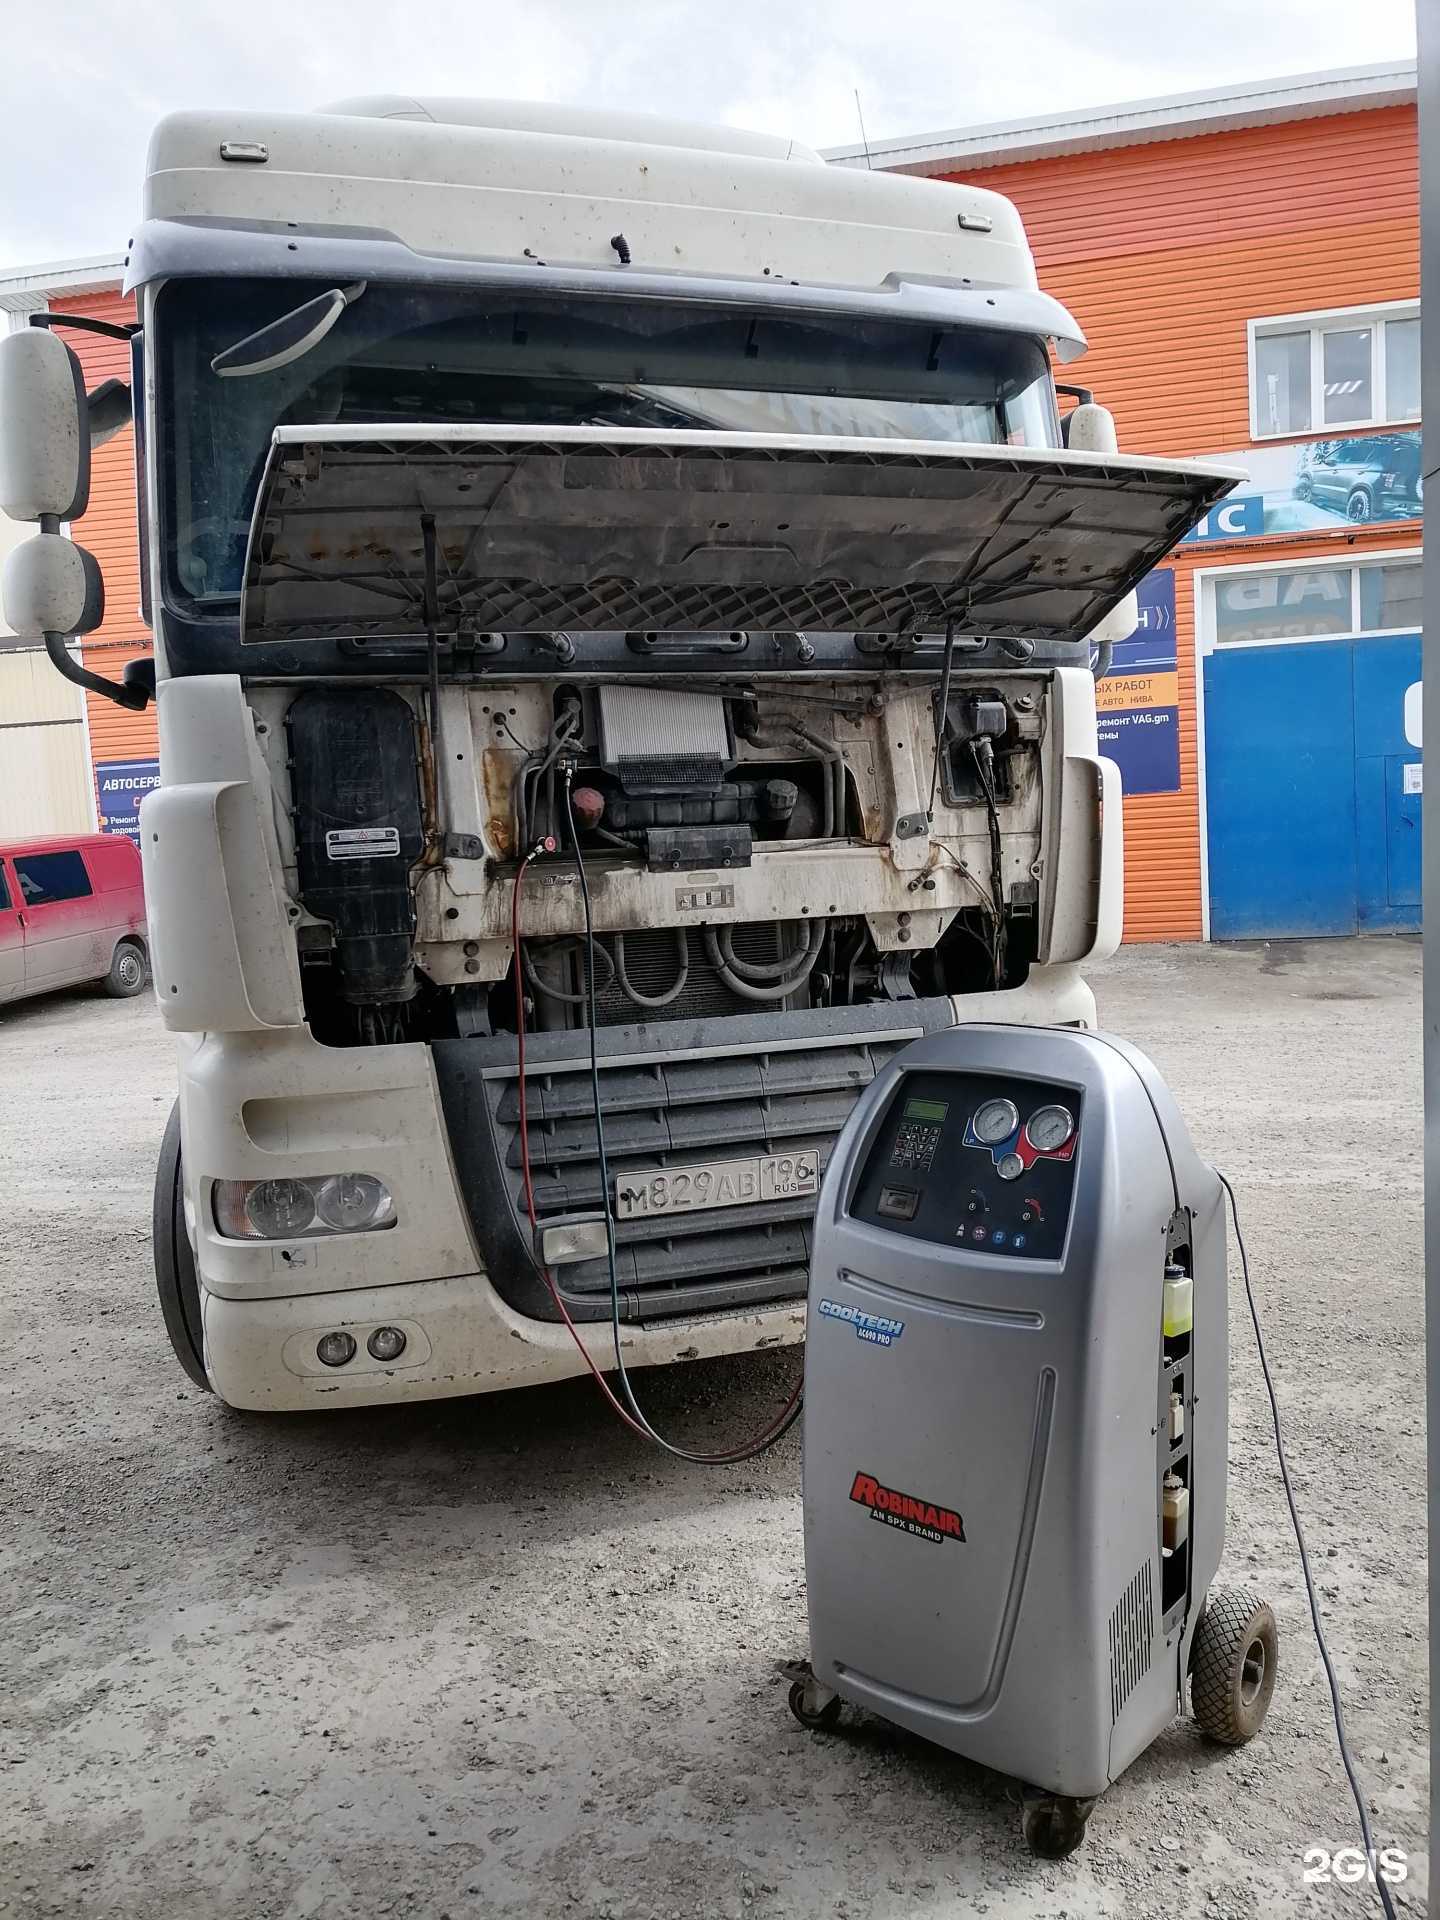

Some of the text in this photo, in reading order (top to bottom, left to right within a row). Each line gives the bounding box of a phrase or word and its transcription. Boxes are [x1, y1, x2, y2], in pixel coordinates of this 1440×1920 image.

[1115, 679, 1152, 692] РАБОТ
[1102, 697, 1124, 706] АВТО
[1130, 695, 1153, 704] НИВА
[110, 816, 137, 825] Ремонт
[764, 1155, 811, 1185] 196
[774, 1183, 798, 1194] RUS
[819, 1300, 903, 1335] COOLTECH
[877, 1332, 890, 1345] PRO
[872, 1509, 941, 1542] AN SPX BRAND
